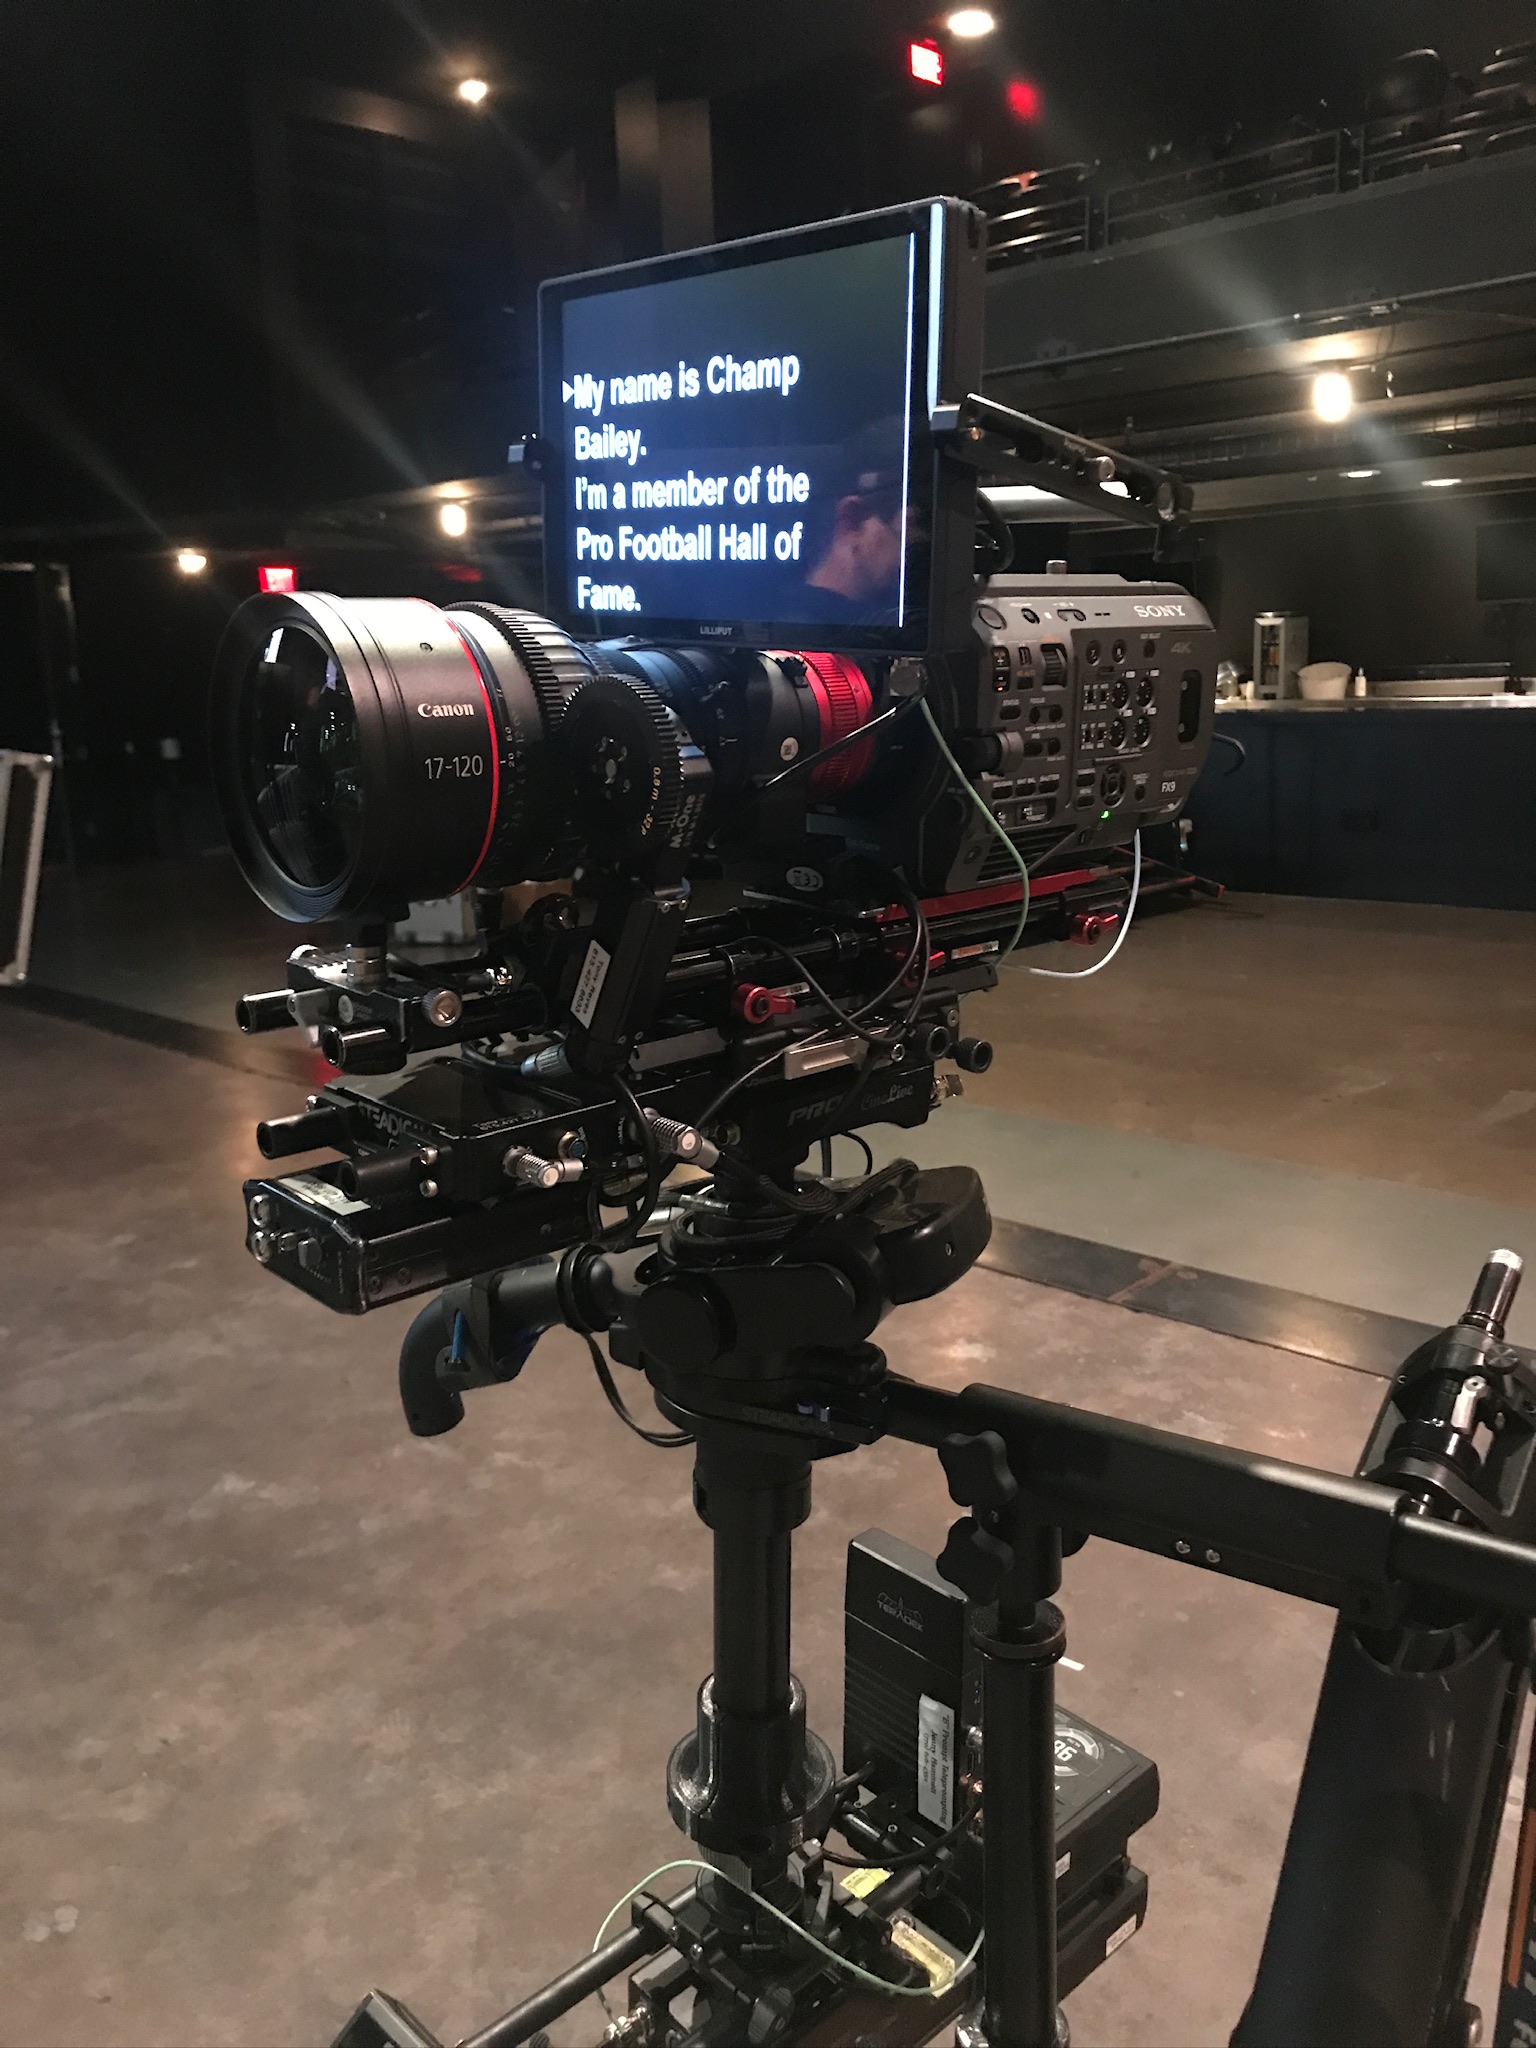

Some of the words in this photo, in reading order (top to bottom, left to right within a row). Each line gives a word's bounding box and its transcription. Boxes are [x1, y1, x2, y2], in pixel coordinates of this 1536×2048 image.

[574, 374, 604, 416] My
[610, 371, 672, 406] name
[678, 361, 700, 398] is
[706, 354, 800, 396] Champ
[574, 424, 647, 465] Bailey.
[575, 476, 607, 511] I'm
[612, 483, 627, 509] a
[632, 469, 728, 508] member
[733, 466, 761, 504] of
[766, 463, 810, 503] the
[576, 526, 613, 561] Pro
[618, 524, 712, 561] Football
[718, 523, 767, 560] Hall
[774, 521, 803, 560] of
[577, 575, 642, 611] Fame.
[1133, 604, 1186, 618] SONY
[700, 626, 733, 636] LILLIPUT
[417, 702, 475, 718] Canon
[424, 754, 484, 780] 17-120
[1161, 781, 1176, 793] FX9
[940, 1729, 950, 1763] Prompt
[939, 1764, 950, 1825] Teleprompting
